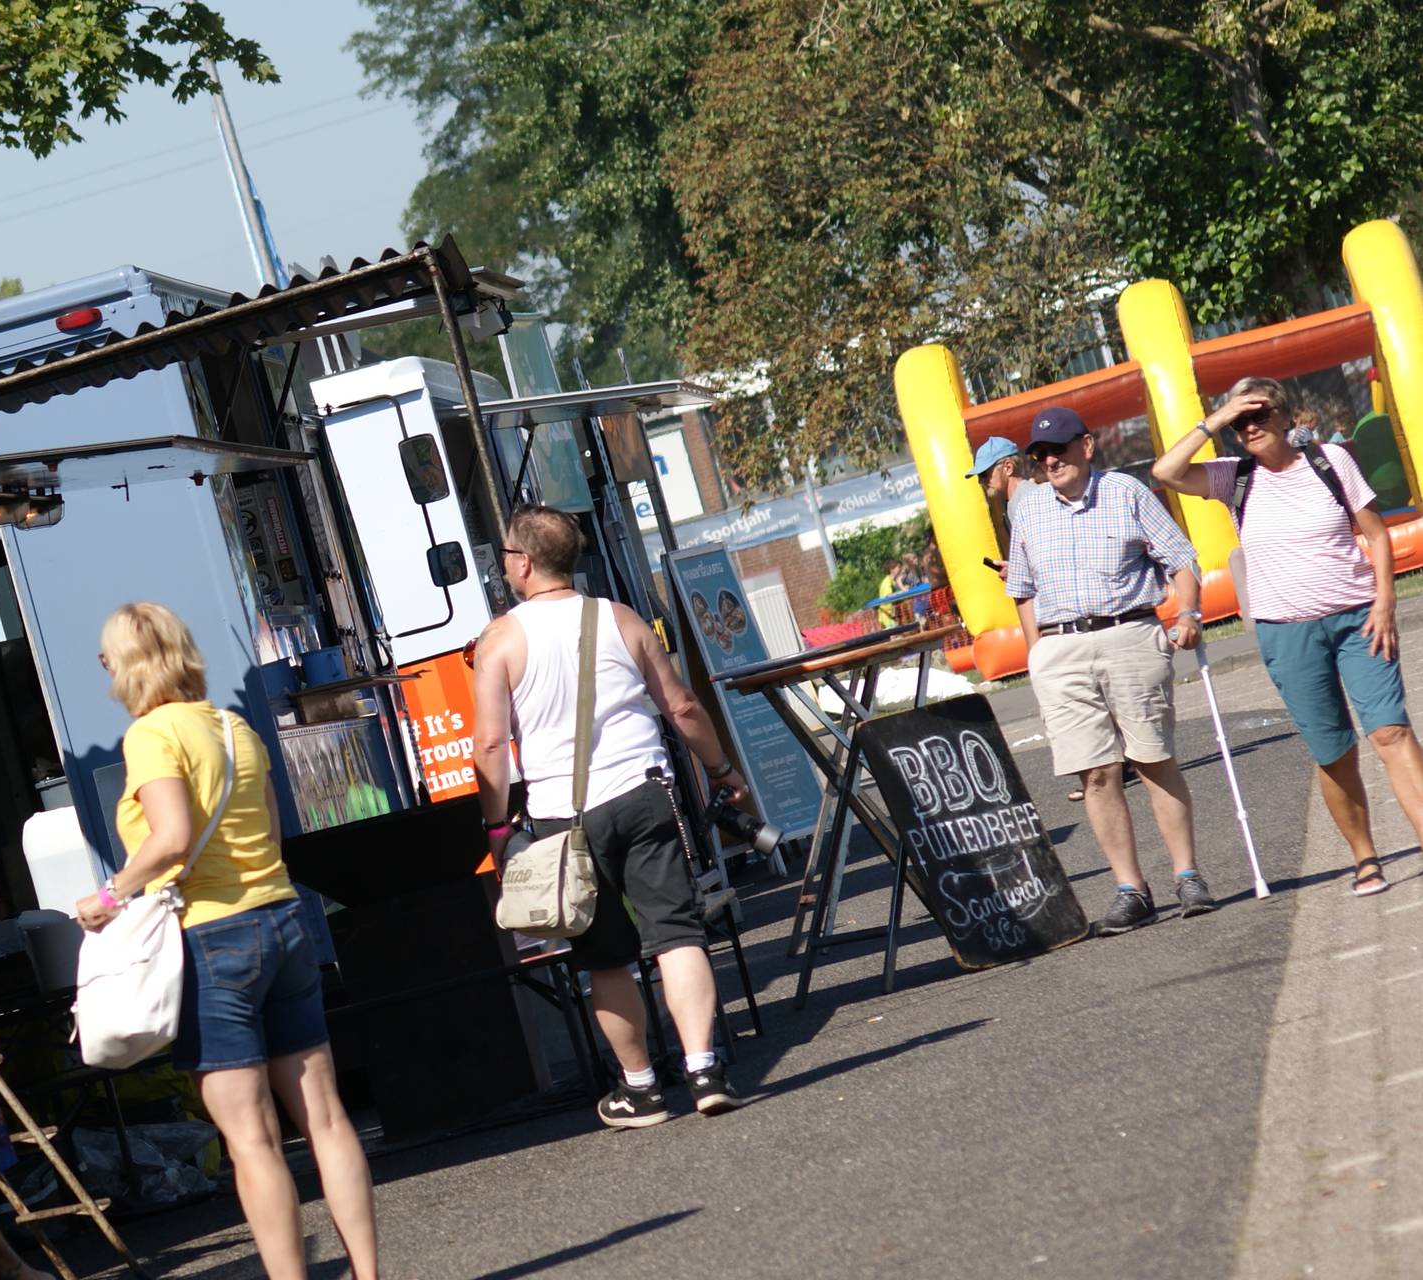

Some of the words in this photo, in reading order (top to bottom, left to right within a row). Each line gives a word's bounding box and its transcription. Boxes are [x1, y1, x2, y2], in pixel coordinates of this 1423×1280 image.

[883, 472, 921, 496] Spor
[702, 506, 773, 544] Sportjahr
[418, 736, 474, 766] roop
[888, 730, 1011, 816] BBQ
[938, 850, 1060, 928] Sandwich
